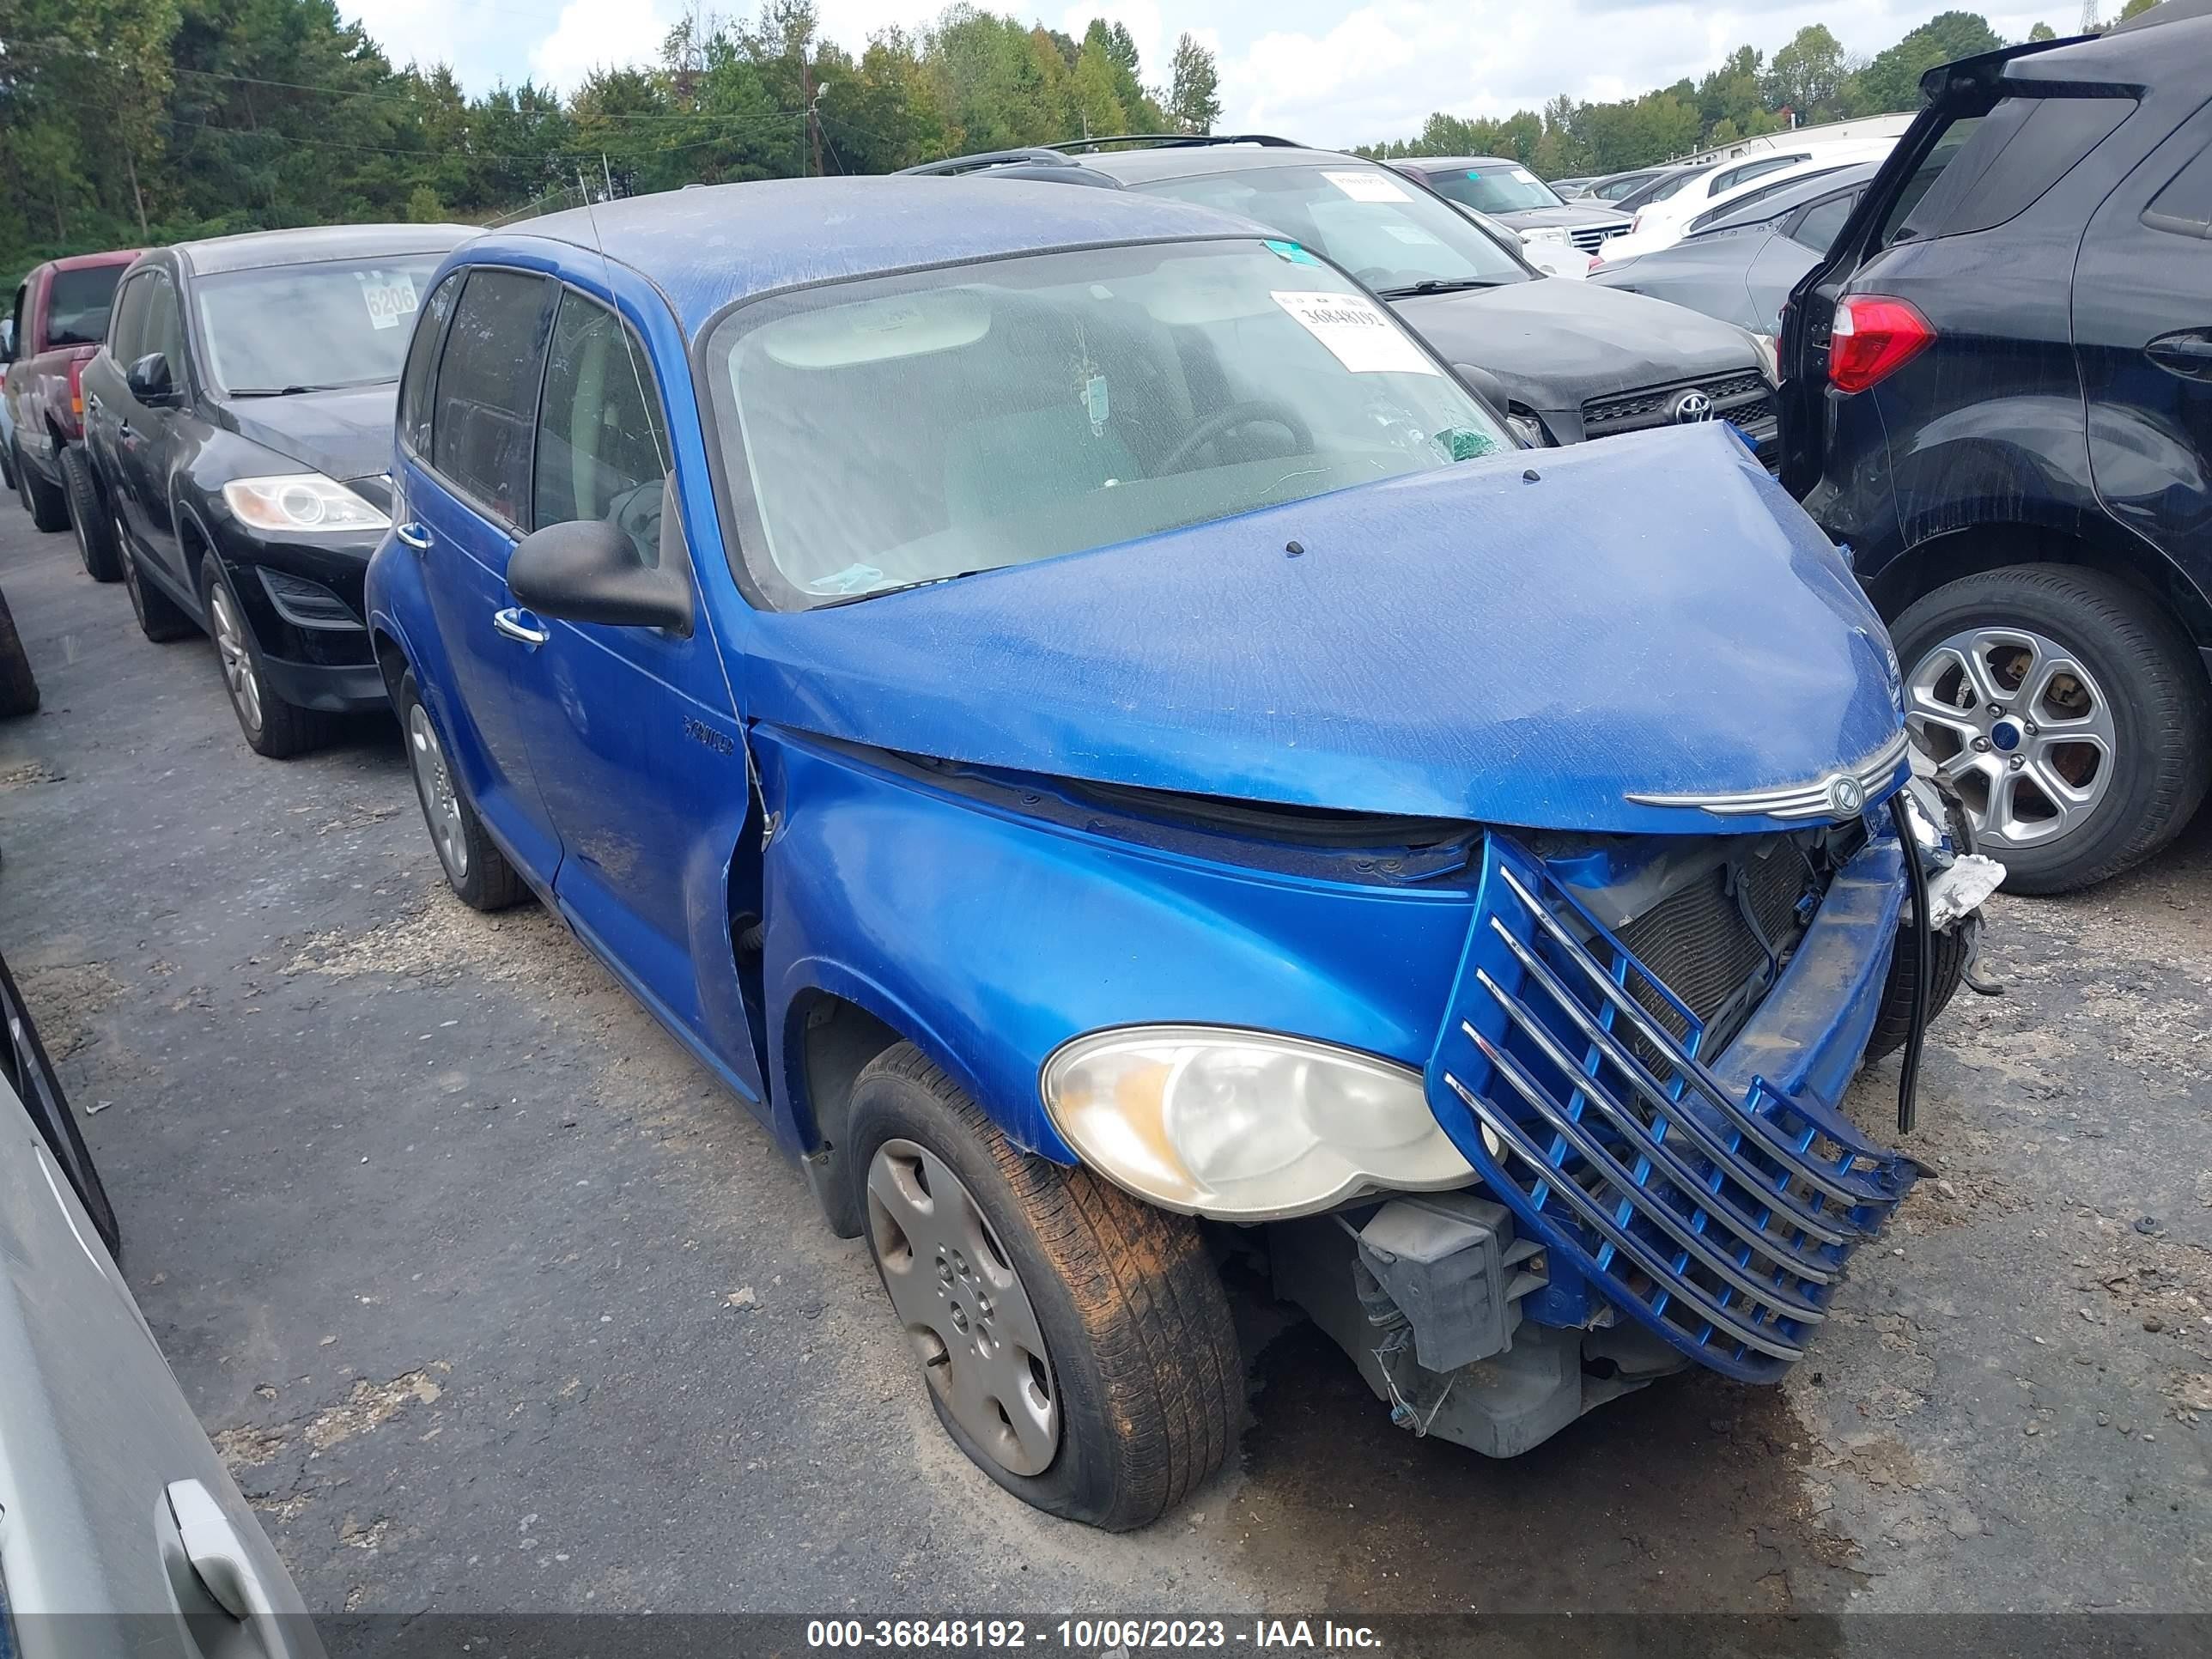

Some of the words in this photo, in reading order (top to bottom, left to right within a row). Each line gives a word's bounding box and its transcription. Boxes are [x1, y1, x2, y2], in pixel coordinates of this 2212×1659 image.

[368, 286, 416, 317] 6206
[1301, 309, 1385, 326] 36848192
[692, 720, 734, 756] CRUISER
